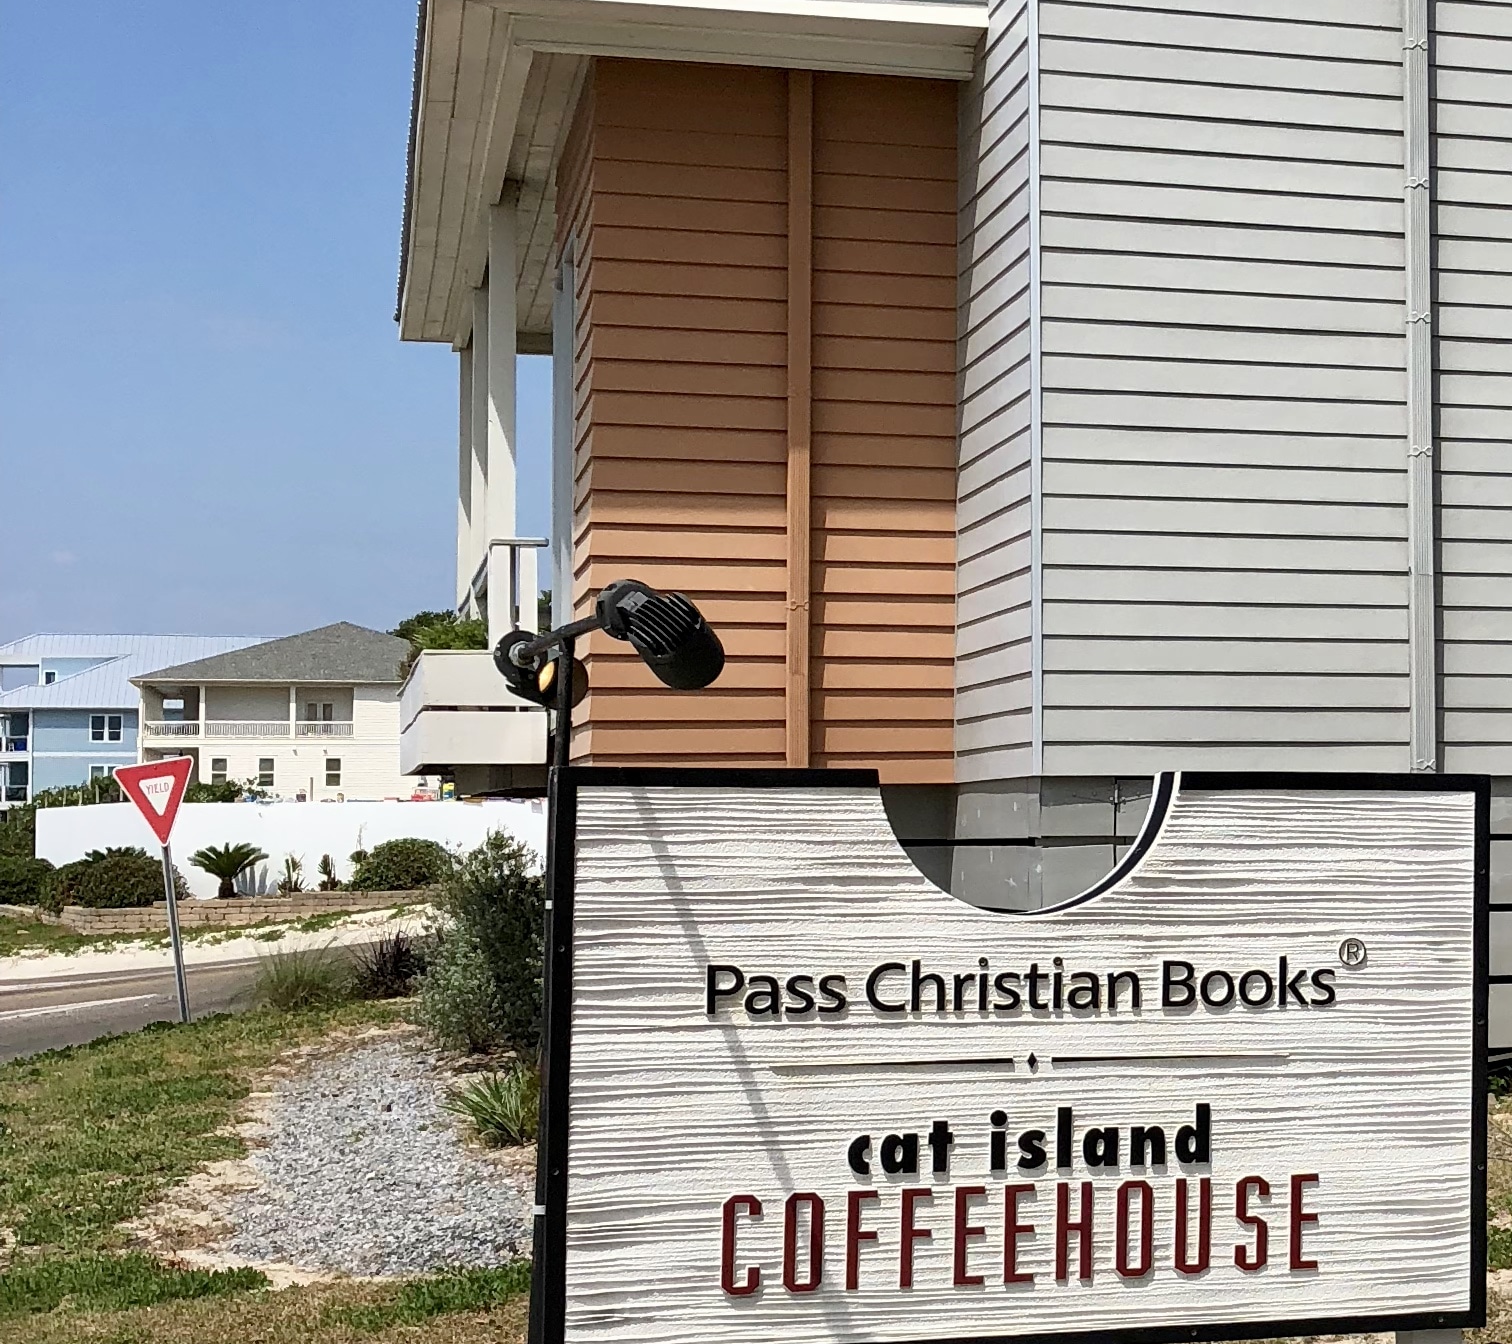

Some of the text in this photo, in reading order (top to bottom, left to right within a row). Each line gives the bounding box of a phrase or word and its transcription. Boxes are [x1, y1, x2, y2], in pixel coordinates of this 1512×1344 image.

[145, 782, 170, 795] YIELD
[706, 964, 851, 1016] Pass
[865, 955, 1143, 1014] Christian
[846, 1102, 1212, 1177] cat island
[720, 1172, 1321, 1297] COFFEEHOUSE
